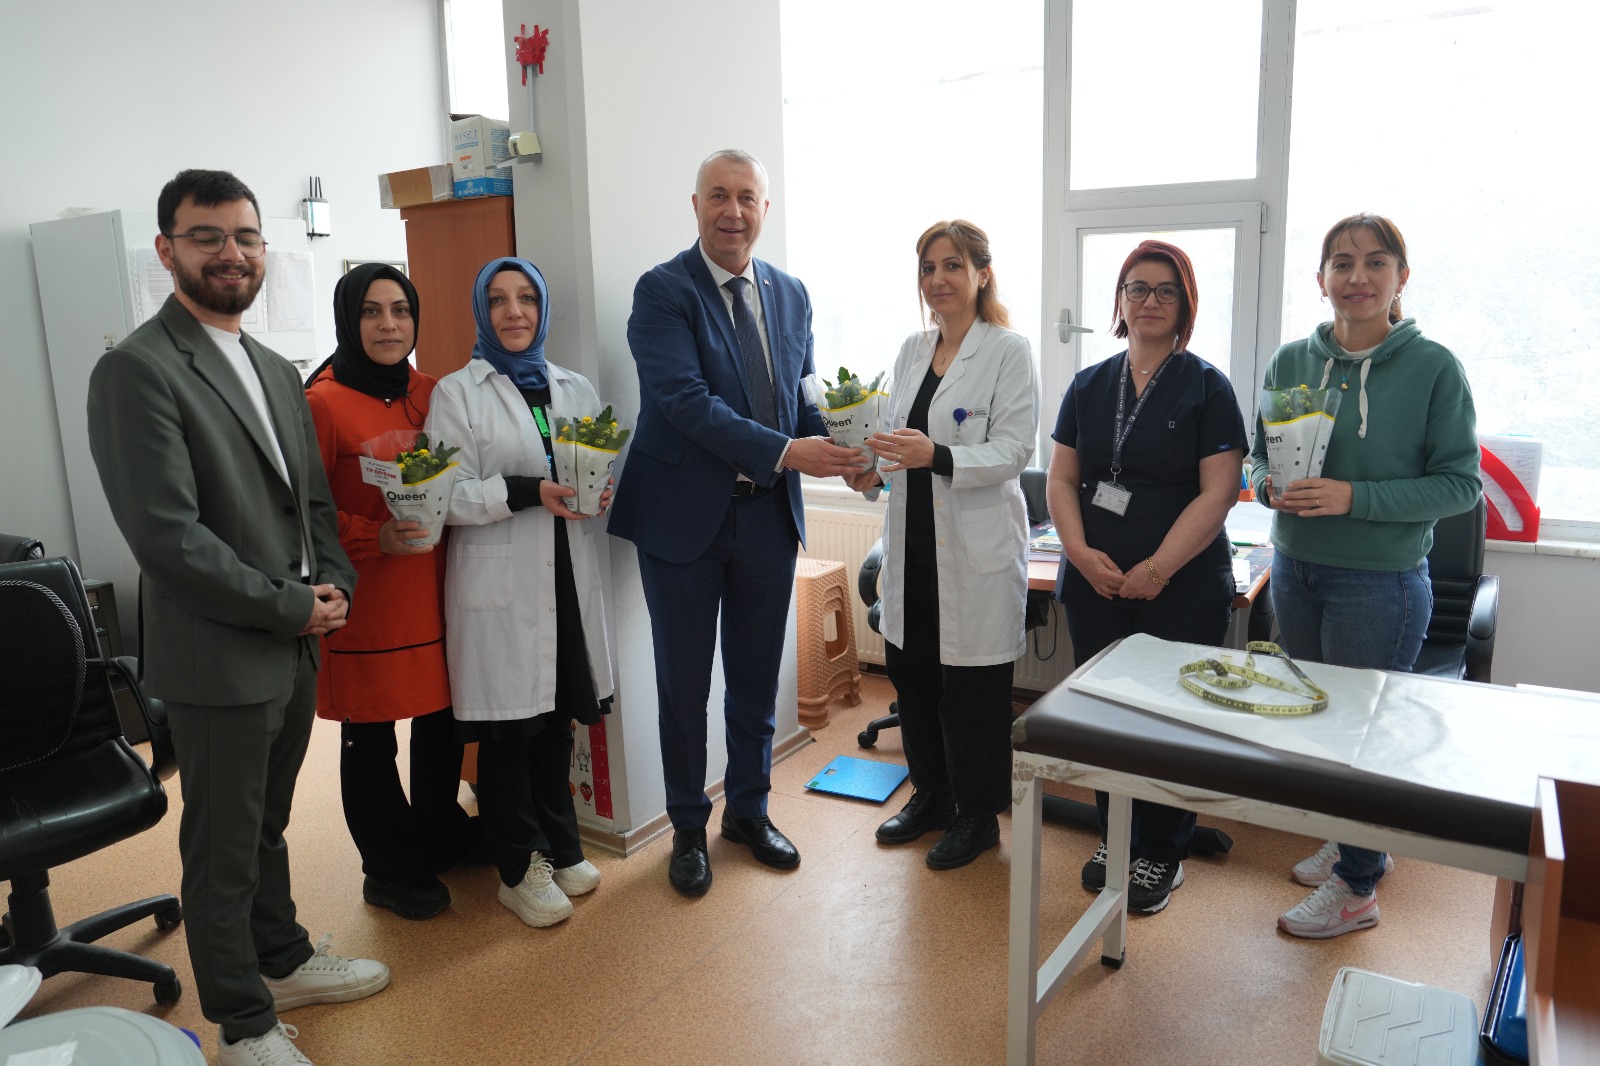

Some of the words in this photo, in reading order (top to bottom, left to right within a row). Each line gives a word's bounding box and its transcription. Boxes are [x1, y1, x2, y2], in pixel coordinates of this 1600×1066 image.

[822, 416, 853, 428] Queen
[1265, 435, 1283, 444] een
[386, 491, 427, 503] Queen
